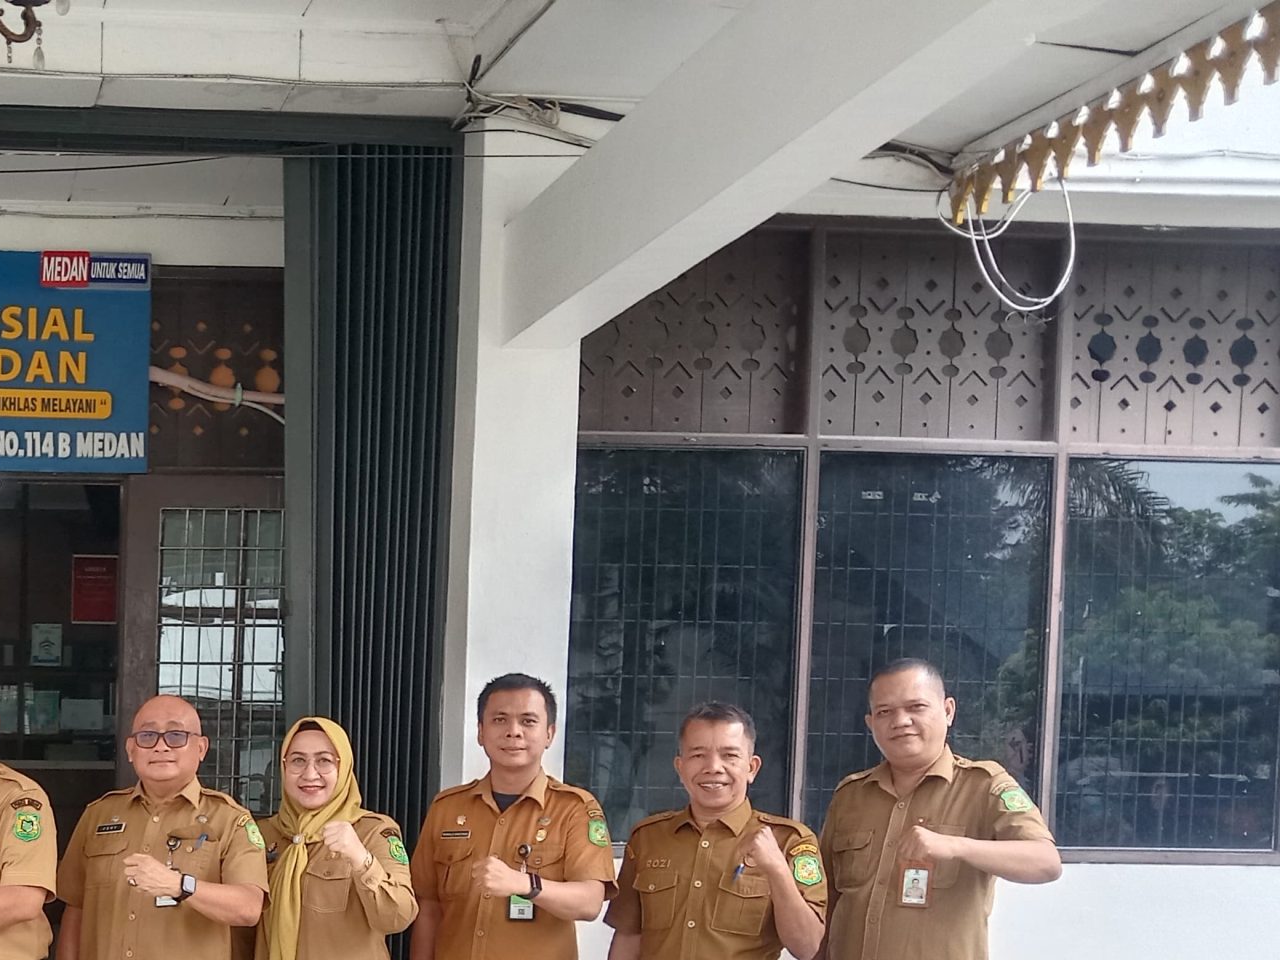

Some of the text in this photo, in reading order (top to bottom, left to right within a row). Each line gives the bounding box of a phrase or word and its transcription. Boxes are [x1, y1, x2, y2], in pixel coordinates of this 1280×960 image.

[42, 256, 146, 282] MEDAN UNTUK SEMUA
[41, 397, 96, 413] MELAYANI
[57, 431, 70, 459] B
[76, 432, 145, 459] MEDAN
